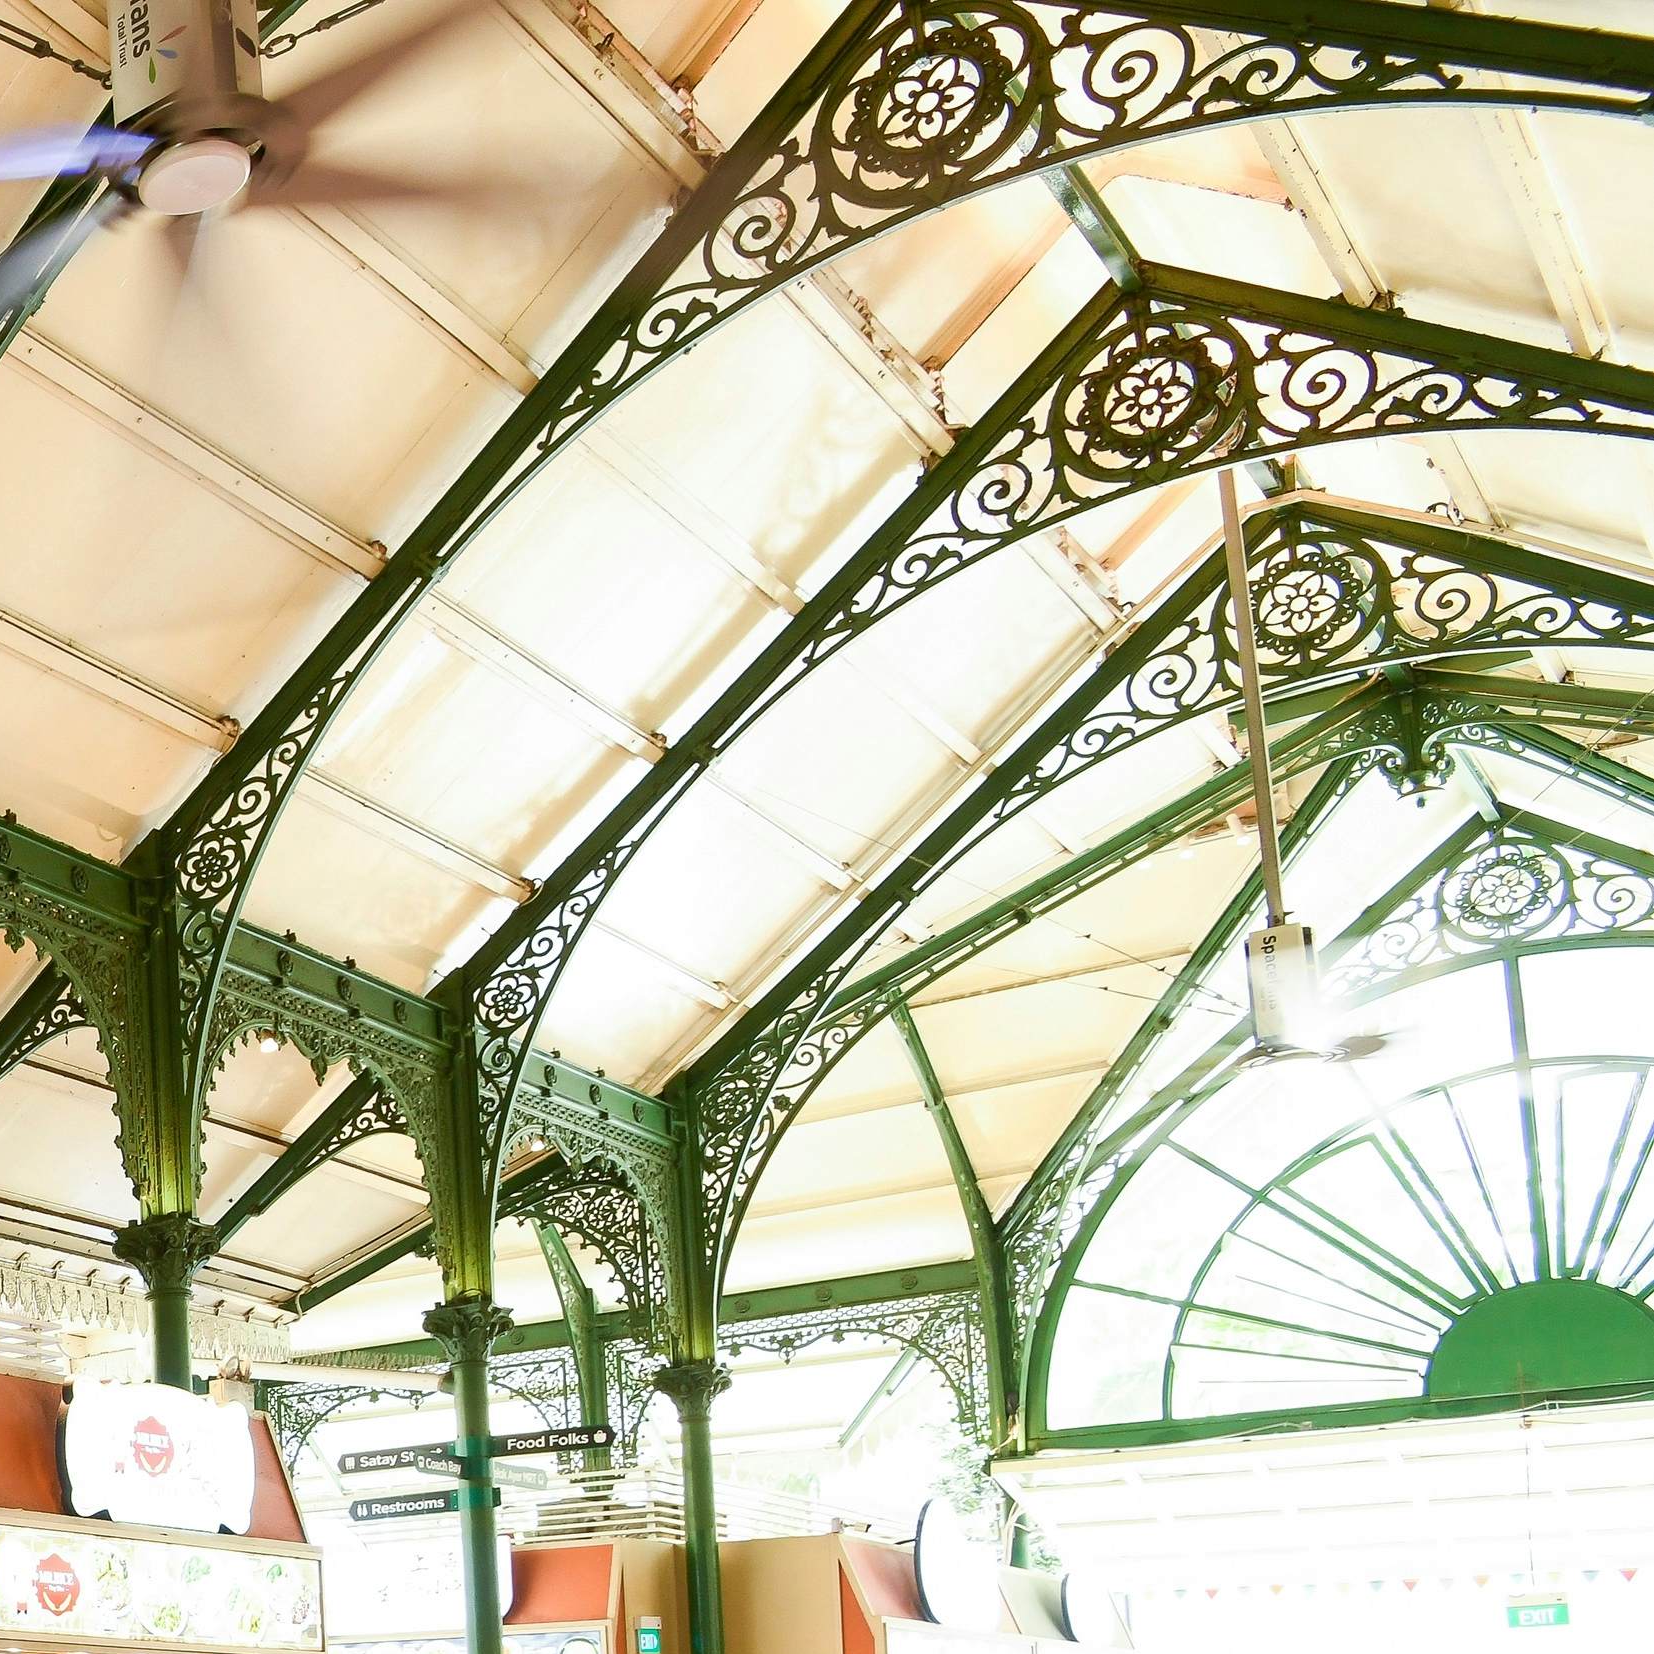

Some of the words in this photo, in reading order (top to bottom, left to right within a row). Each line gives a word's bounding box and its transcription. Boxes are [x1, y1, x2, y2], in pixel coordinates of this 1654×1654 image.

[117, 14, 125, 39] Total
[118, 39, 127, 68] Trust
[507, 1437, 545, 1451] Food
[549, 1432, 589, 1446] Folks
[359, 1456, 393, 1471] Satay
[425, 1458, 446, 1472] Coach
[447, 1461, 462, 1475] Bay
[371, 1498, 445, 1515] Restrooms
[1519, 1609, 1555, 1624] EXIT
